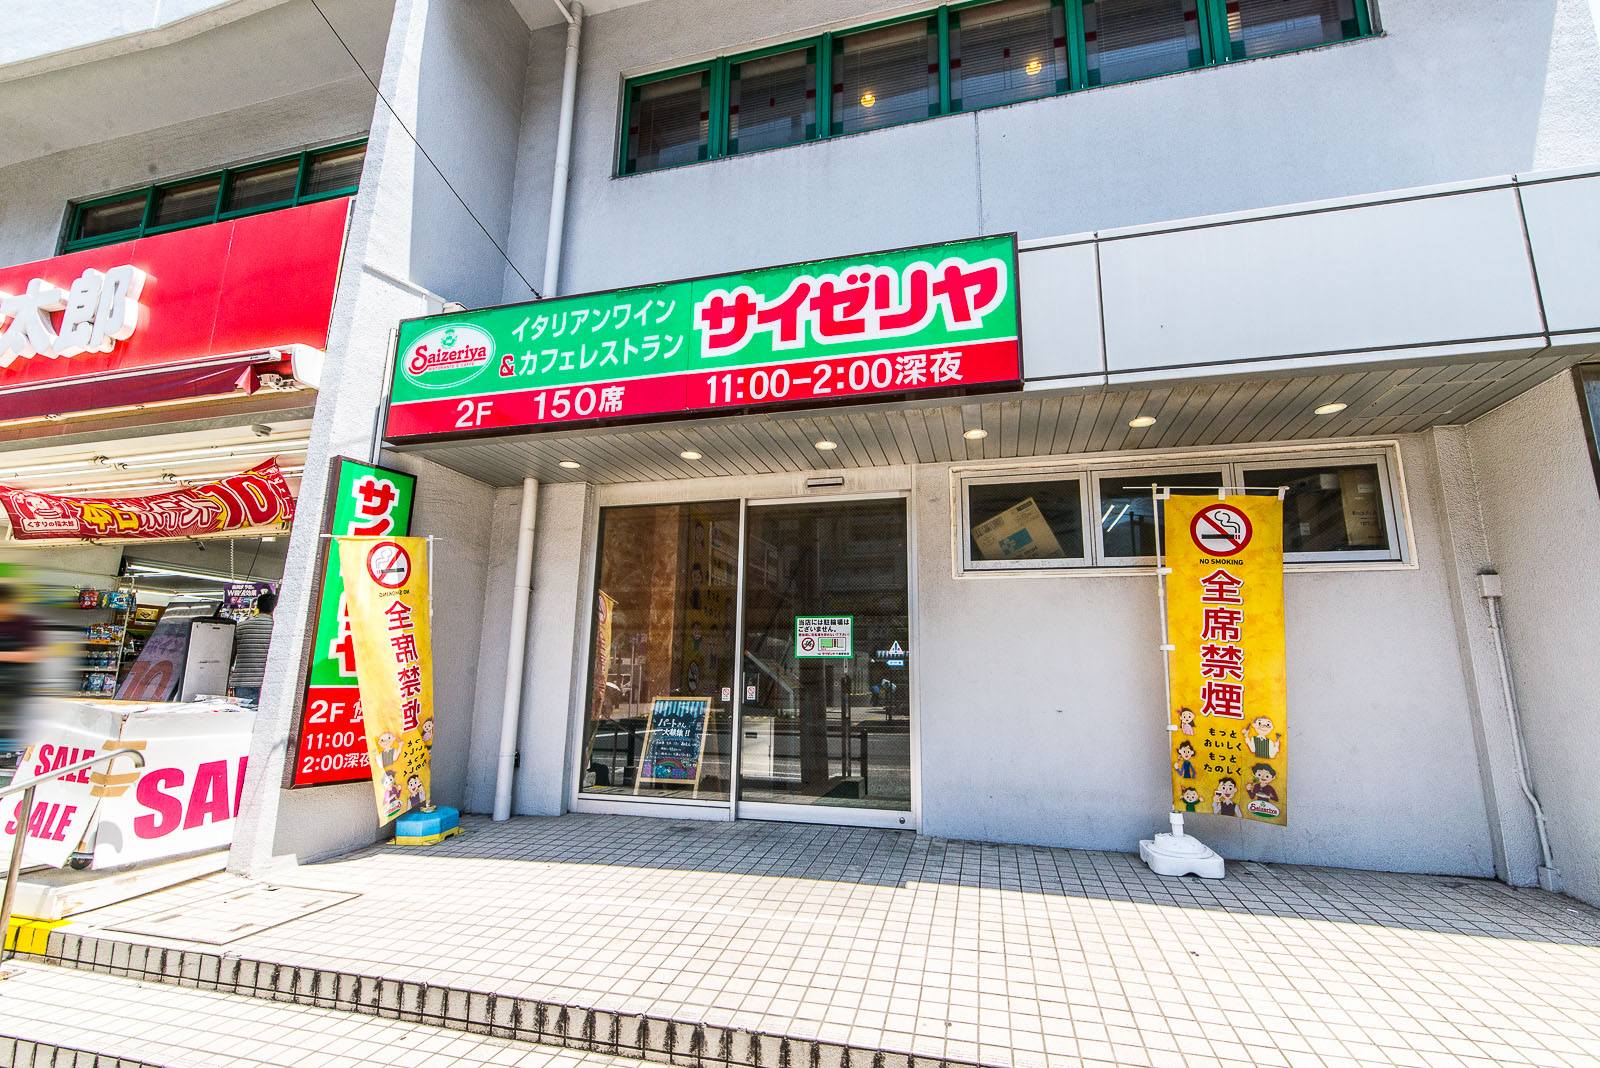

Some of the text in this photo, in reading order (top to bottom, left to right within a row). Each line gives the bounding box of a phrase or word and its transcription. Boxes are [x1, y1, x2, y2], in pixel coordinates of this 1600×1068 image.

[511, 300, 676, 342] イタリアンワイン
[698, 261, 1003, 354] サイゼリヤ
[408, 345, 487, 372] Saizeriya
[455, 386, 625, 428] 2F 150席
[1210, 558, 1244, 566] SMOKING
[1201, 569, 1244, 719] 全席禁煙
[308, 699, 346, 724] 2F
[1203, 738, 1242, 752] おいしく
[1208, 727, 1238, 739] もっと
[34, 743, 96, 785] SALE
[1203, 763, 1242, 776] たのしく
[1208, 752, 1238, 764] もっと
[4, 799, 78, 842] SALE
